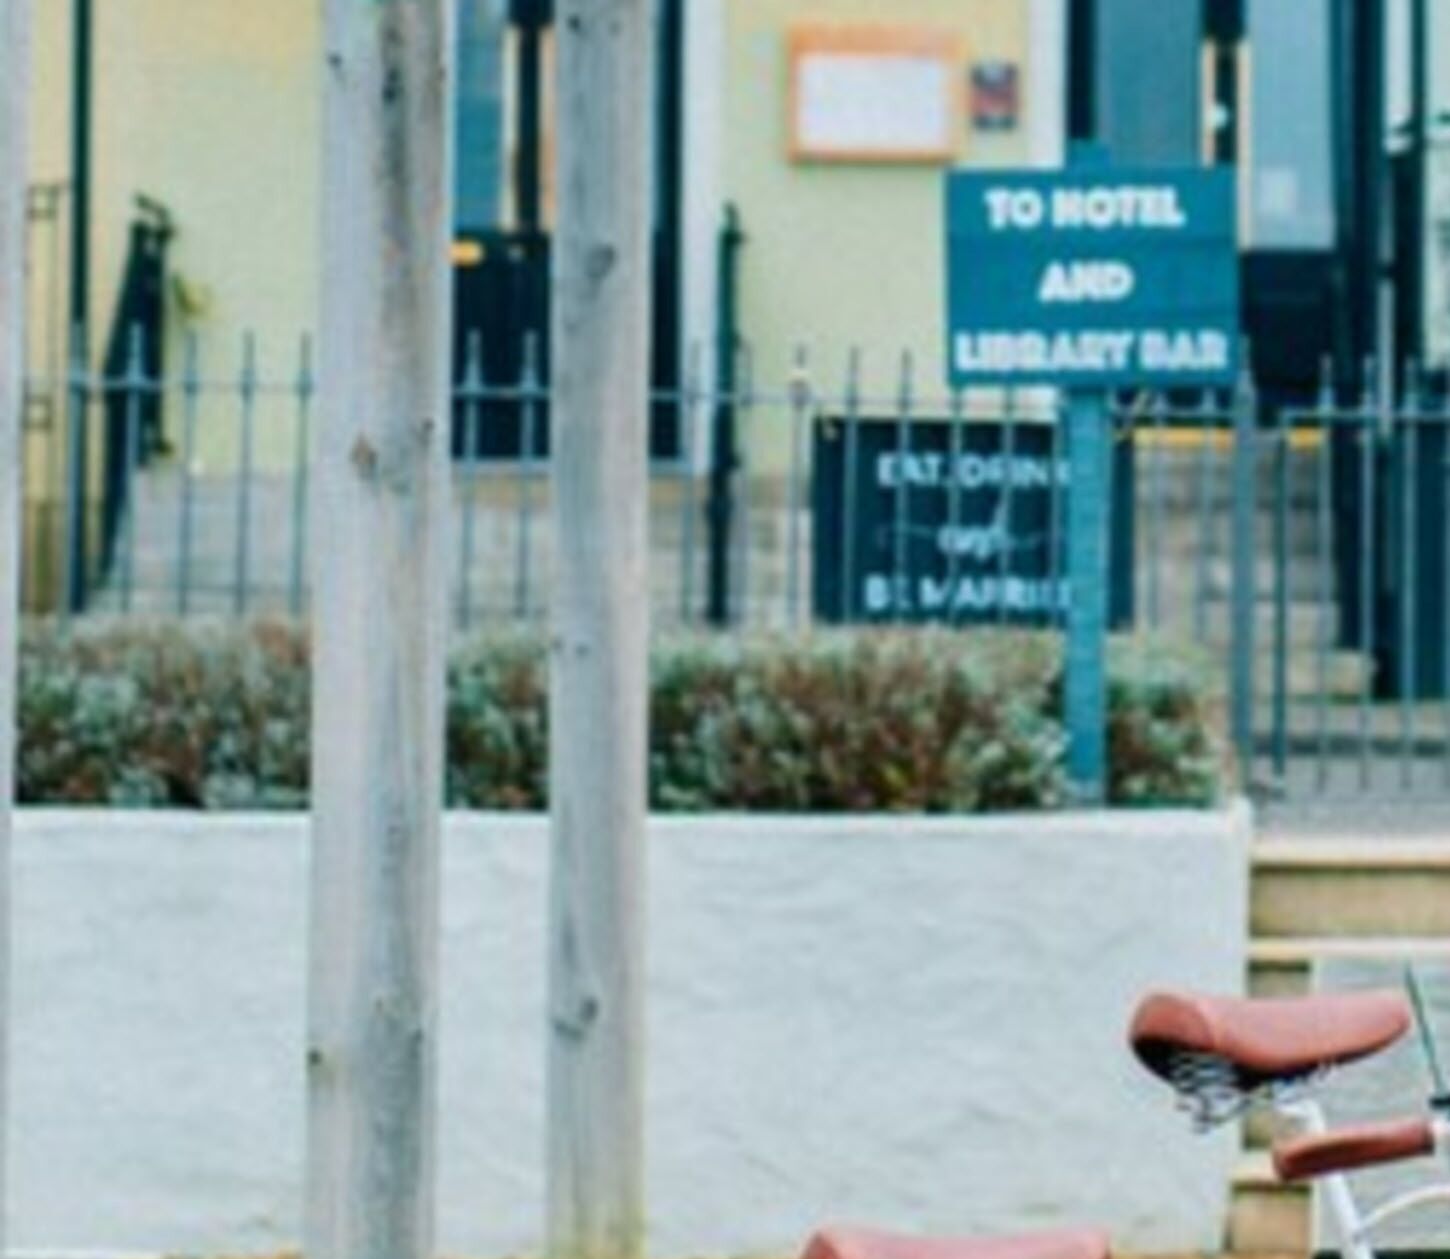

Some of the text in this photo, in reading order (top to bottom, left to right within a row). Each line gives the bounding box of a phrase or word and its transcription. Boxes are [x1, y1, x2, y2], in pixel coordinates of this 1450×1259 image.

[984, 186, 1185, 229] TO HOTEL
[1039, 261, 1134, 301] AND
[955, 330, 1229, 371] LIBRARY BAR
